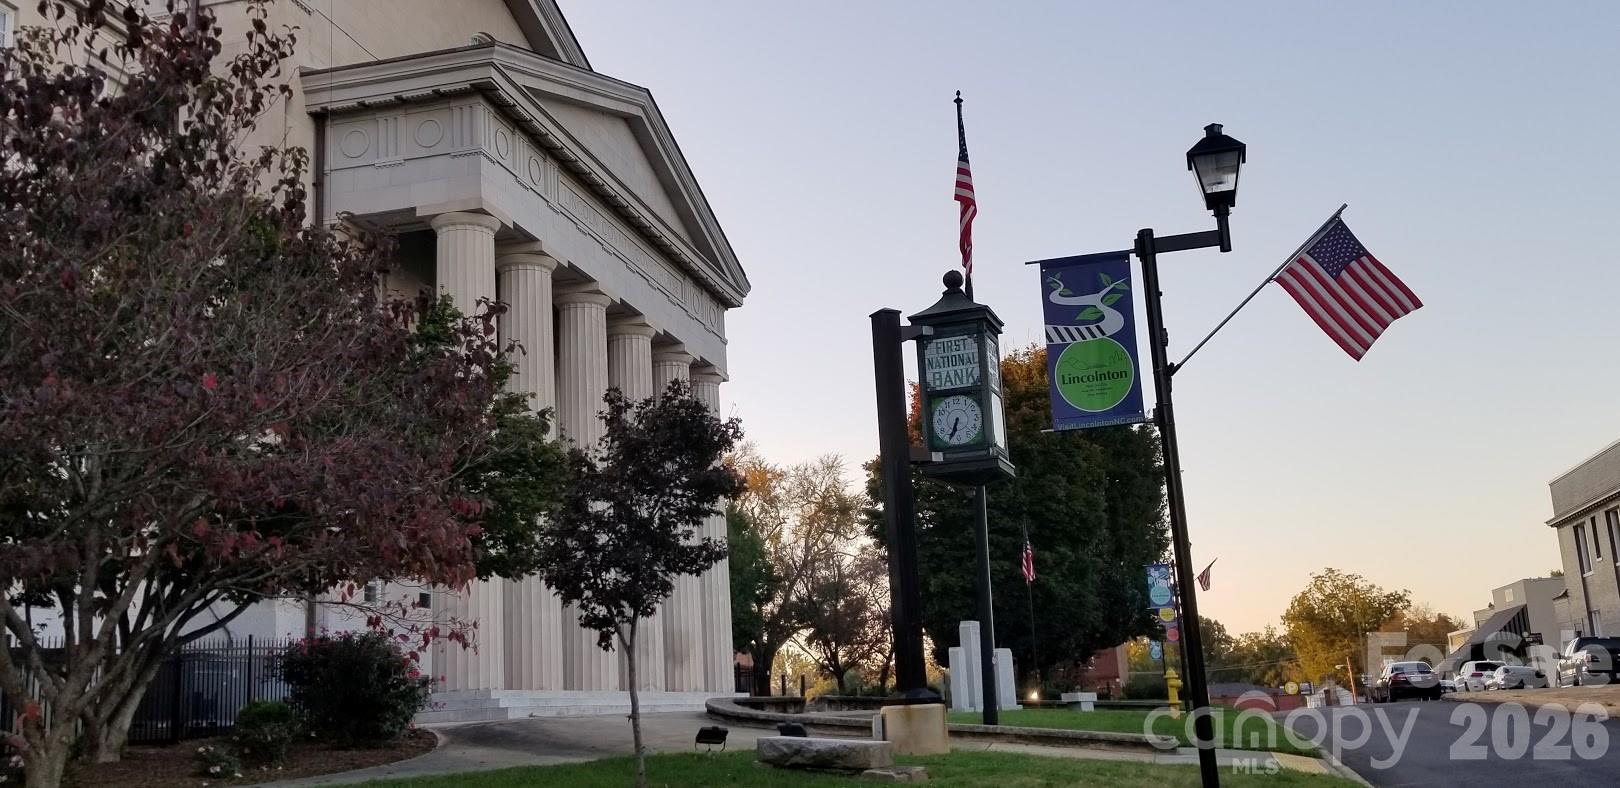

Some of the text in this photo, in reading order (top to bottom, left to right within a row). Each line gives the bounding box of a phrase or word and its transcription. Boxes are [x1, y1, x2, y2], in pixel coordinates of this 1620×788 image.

[935, 338, 967, 354] FIRST
[926, 353, 979, 370] NATIONAL
[932, 366, 976, 387] BANK
[1061, 370, 1128, 385] Lincolnton
